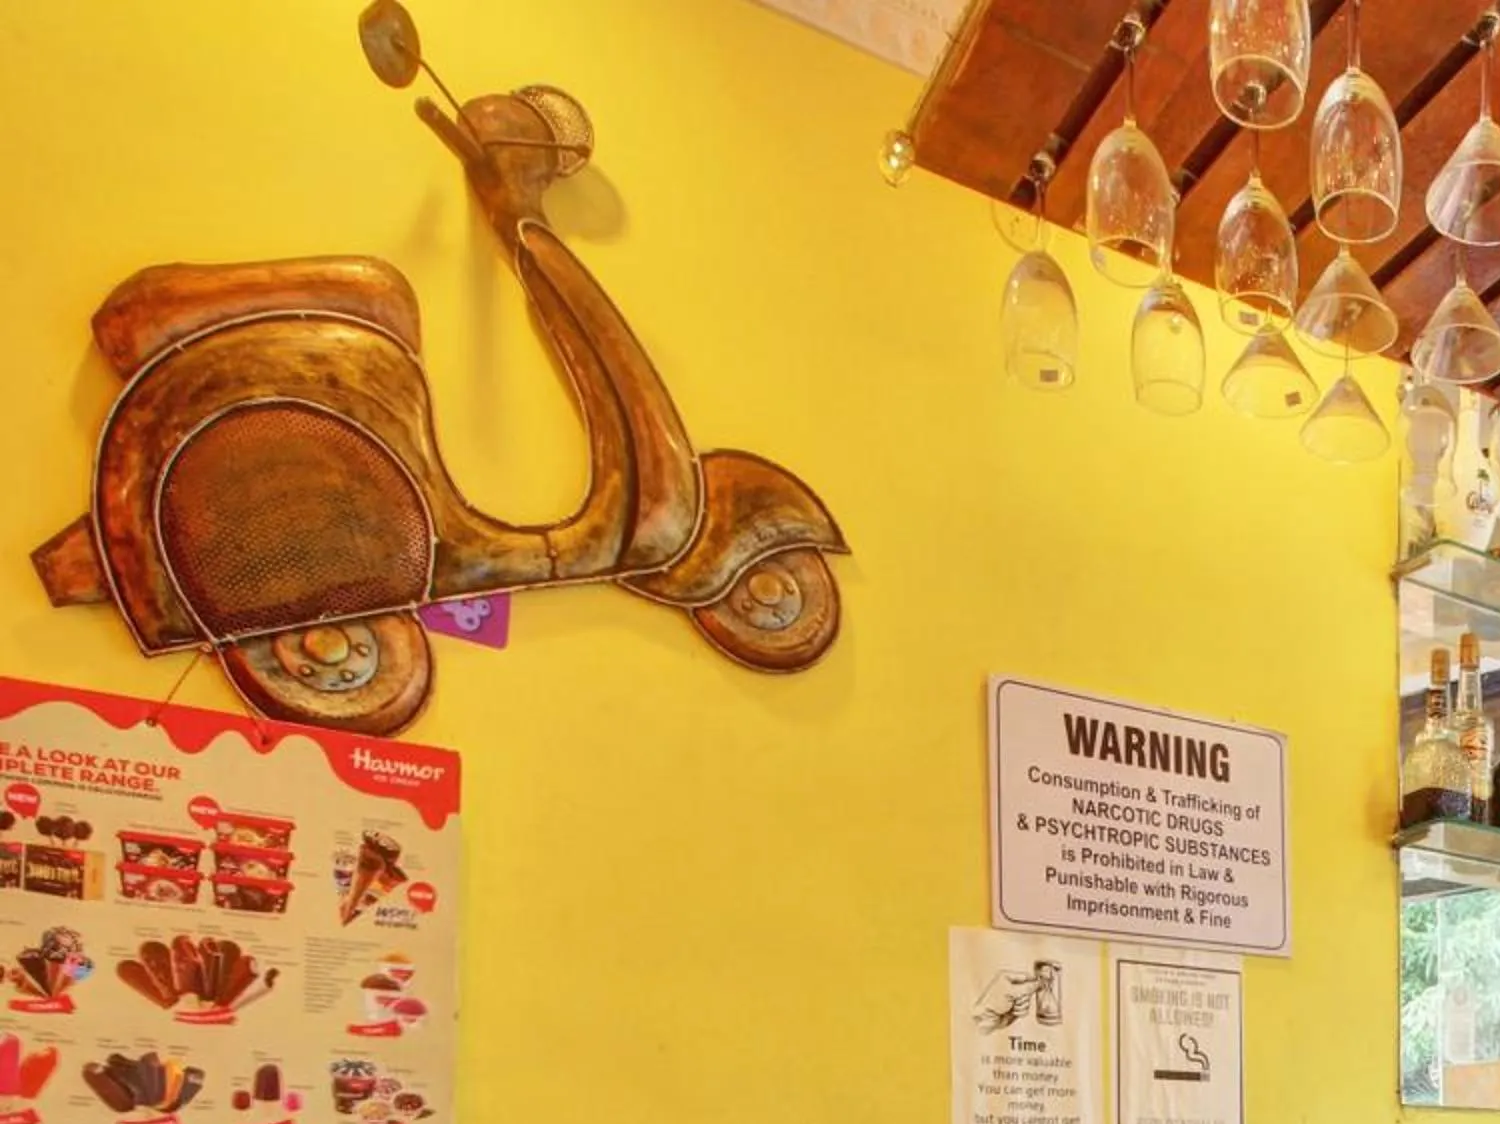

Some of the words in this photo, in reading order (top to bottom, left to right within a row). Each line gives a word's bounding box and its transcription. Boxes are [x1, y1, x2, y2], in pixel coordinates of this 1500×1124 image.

[16, 745, 31, 759] A
[37, 747, 98, 768] LOOK
[103, 757, 131, 773] AT
[134, 761, 181, 780] OUR
[349, 747, 445, 780] Havmor
[1063, 713, 1230, 783] WARNING
[1027, 765, 1140, 800] Consumption
[1146, 786, 1157, 803] &
[1161, 789, 1241, 821] Trafficking
[1245, 805, 1261, 820] of
[1072, 797, 1161, 828] NARCOTIC
[1167, 813, 1224, 837] DRUGS
[1017, 812, 1029, 831] &
[1035, 815, 1160, 851] PSYCHTROPIC
[1165, 835, 1271, 866] SUBSTANCES
[1061, 844, 1076, 862] is
[1081, 847, 1165, 875] Prohibited
[1169, 858, 1185, 876] in
[1189, 863, 1219, 881] Law
[1223, 867, 1235, 883] &
[1045, 866, 1139, 895] Punishable
[1143, 880, 1176, 899] with
[1180, 884, 1249, 907] Rigorous
[1067, 893, 1180, 922] Imprisonment
[1184, 907, 1196, 924] &
[1199, 909, 1232, 928] Fine
[1008, 1036, 1047, 1052] Time
